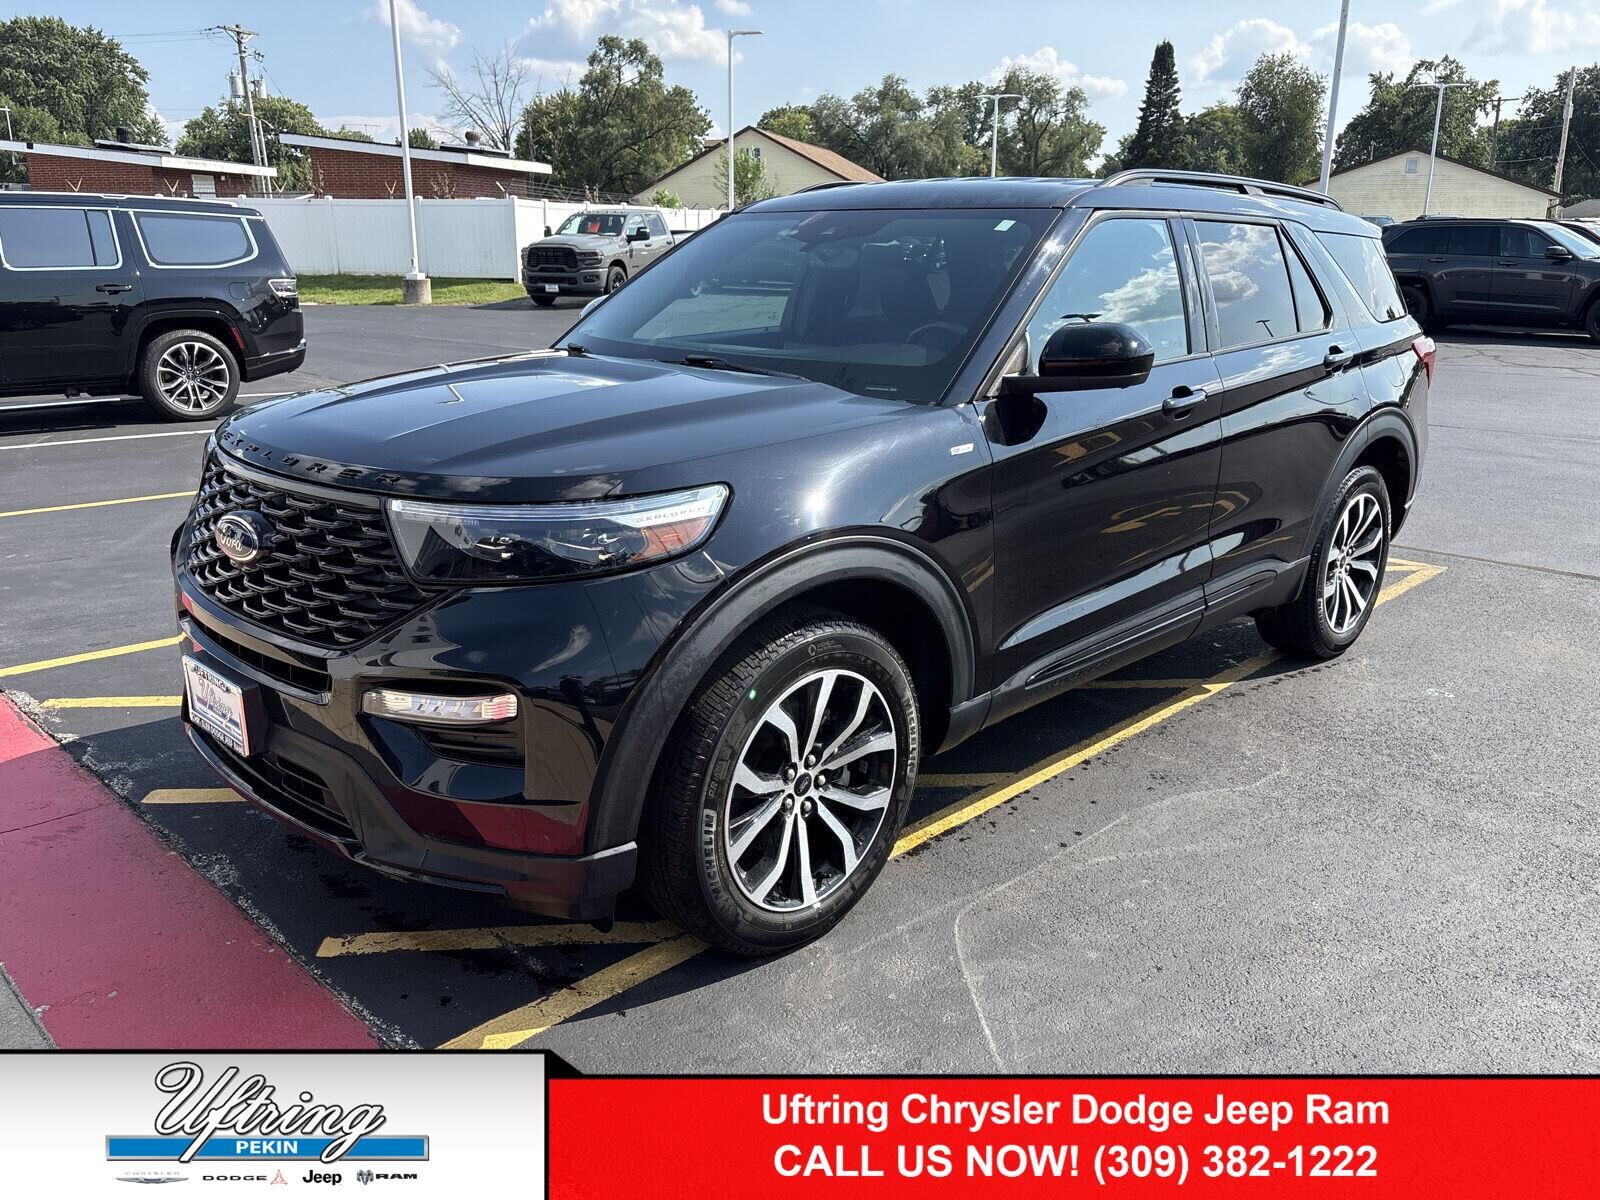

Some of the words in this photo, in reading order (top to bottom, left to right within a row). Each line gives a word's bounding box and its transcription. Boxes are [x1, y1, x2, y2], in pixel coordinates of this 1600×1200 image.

[222, 430, 402, 486] EXPLORER
[219, 521, 245, 553] Ford
[635, 506, 706, 523] EXPLORER
[904, 698, 918, 773] MICHELIN
[703, 813, 724, 900] MICHELIN
